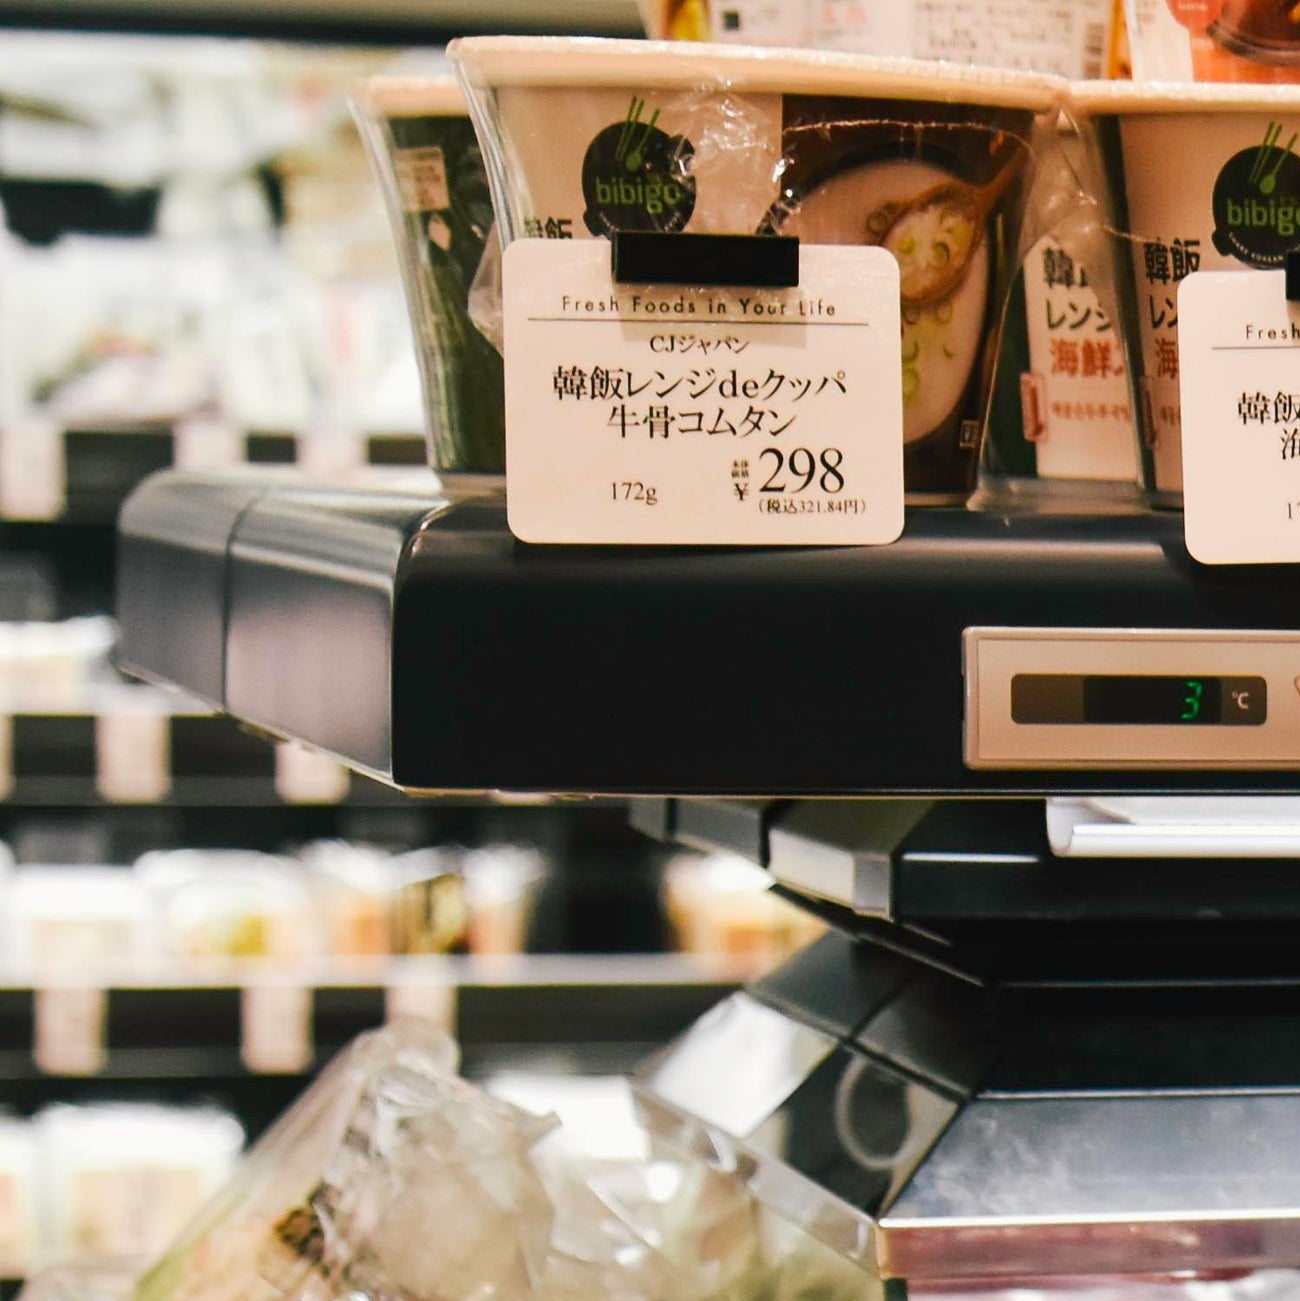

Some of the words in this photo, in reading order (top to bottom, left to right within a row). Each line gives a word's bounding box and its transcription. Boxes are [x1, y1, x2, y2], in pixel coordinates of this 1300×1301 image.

[595, 179, 683, 214] bibigo
[561, 295, 617, 315] Fresh
[632, 297, 696, 316] Foods
[708, 299, 727, 315] in
[739, 301, 787, 317] Your
[649, 334, 750, 356] CJジャパン
[552, 367, 847, 401] 韓飯レンジdeクッパ
[606, 405, 798, 440] 牛骨コムタン
[758, 447, 846, 495] 298
[610, 481, 658, 506] 172g
[1180, 681, 1201, 720] 3
